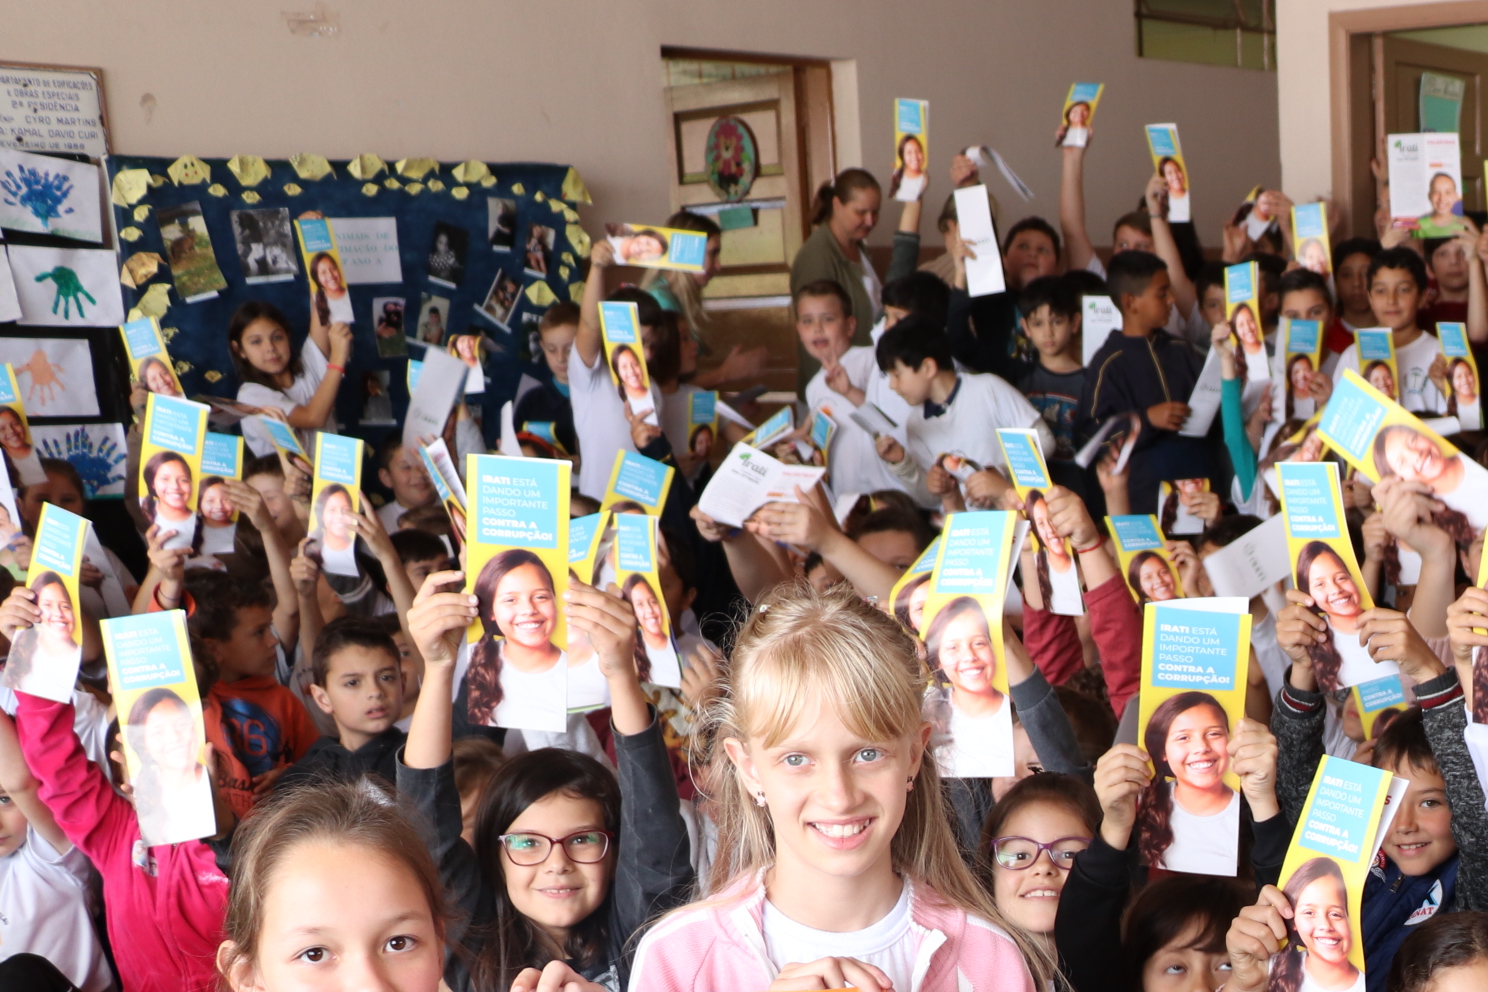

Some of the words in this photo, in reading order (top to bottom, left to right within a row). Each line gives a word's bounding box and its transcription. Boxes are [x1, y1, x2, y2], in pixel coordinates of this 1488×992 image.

[14, 88, 39, 99] OBRAS
[42, 91, 80, 101] ESPECIAIS
[25, 115, 51, 124] CYRO
[57, 117, 97, 127] MARTINS
[10, 127, 43, 137] KAMAL
[48, 129, 75, 139] DAVID
[78, 130, 98, 139] CURI
[483, 475, 511, 485] IRATI
[513, 477, 538, 488] ESTÁ
[483, 485, 521, 498] DANDO
[524, 489, 541, 498] UM
[483, 496, 548, 510] IMPORTANTE
[483, 507, 516, 517] PASSO
[482, 517, 526, 529] CONTRA
[529, 521, 538, 530] A
[482, 527, 553, 541] CORRUPÇÃO!
[115, 631, 137, 640] IRATI
[1160, 624, 1189, 633] IRATI
[1192, 627, 1217, 635] ESTÁ
[1160, 634, 1200, 644] DANDO
[1160, 644, 1227, 655] IMPORTANTE
[1159, 653, 1193, 663] PASSO
[122, 664, 157, 675] CONTRA
[1158, 663, 1204, 673] CONTRA
[123, 670, 180, 683] CORRUPÇÃO!
[1158, 672, 1230, 684] CORRUPÇÃO!
[1323, 776, 1343, 787] IRATI
[1343, 781, 1362, 792] ESTÁ
[1320, 787, 1347, 800] DANDO
[1348, 795, 1361, 804] UM
[1316, 798, 1364, 818] IMPORTANTE
[1312, 809, 1336, 822] PASSO
[1309, 820, 1340, 836] CONTRA
[1341, 830, 1349, 838] A
[1305, 831, 1358, 853] CORRUPÇÃO!
